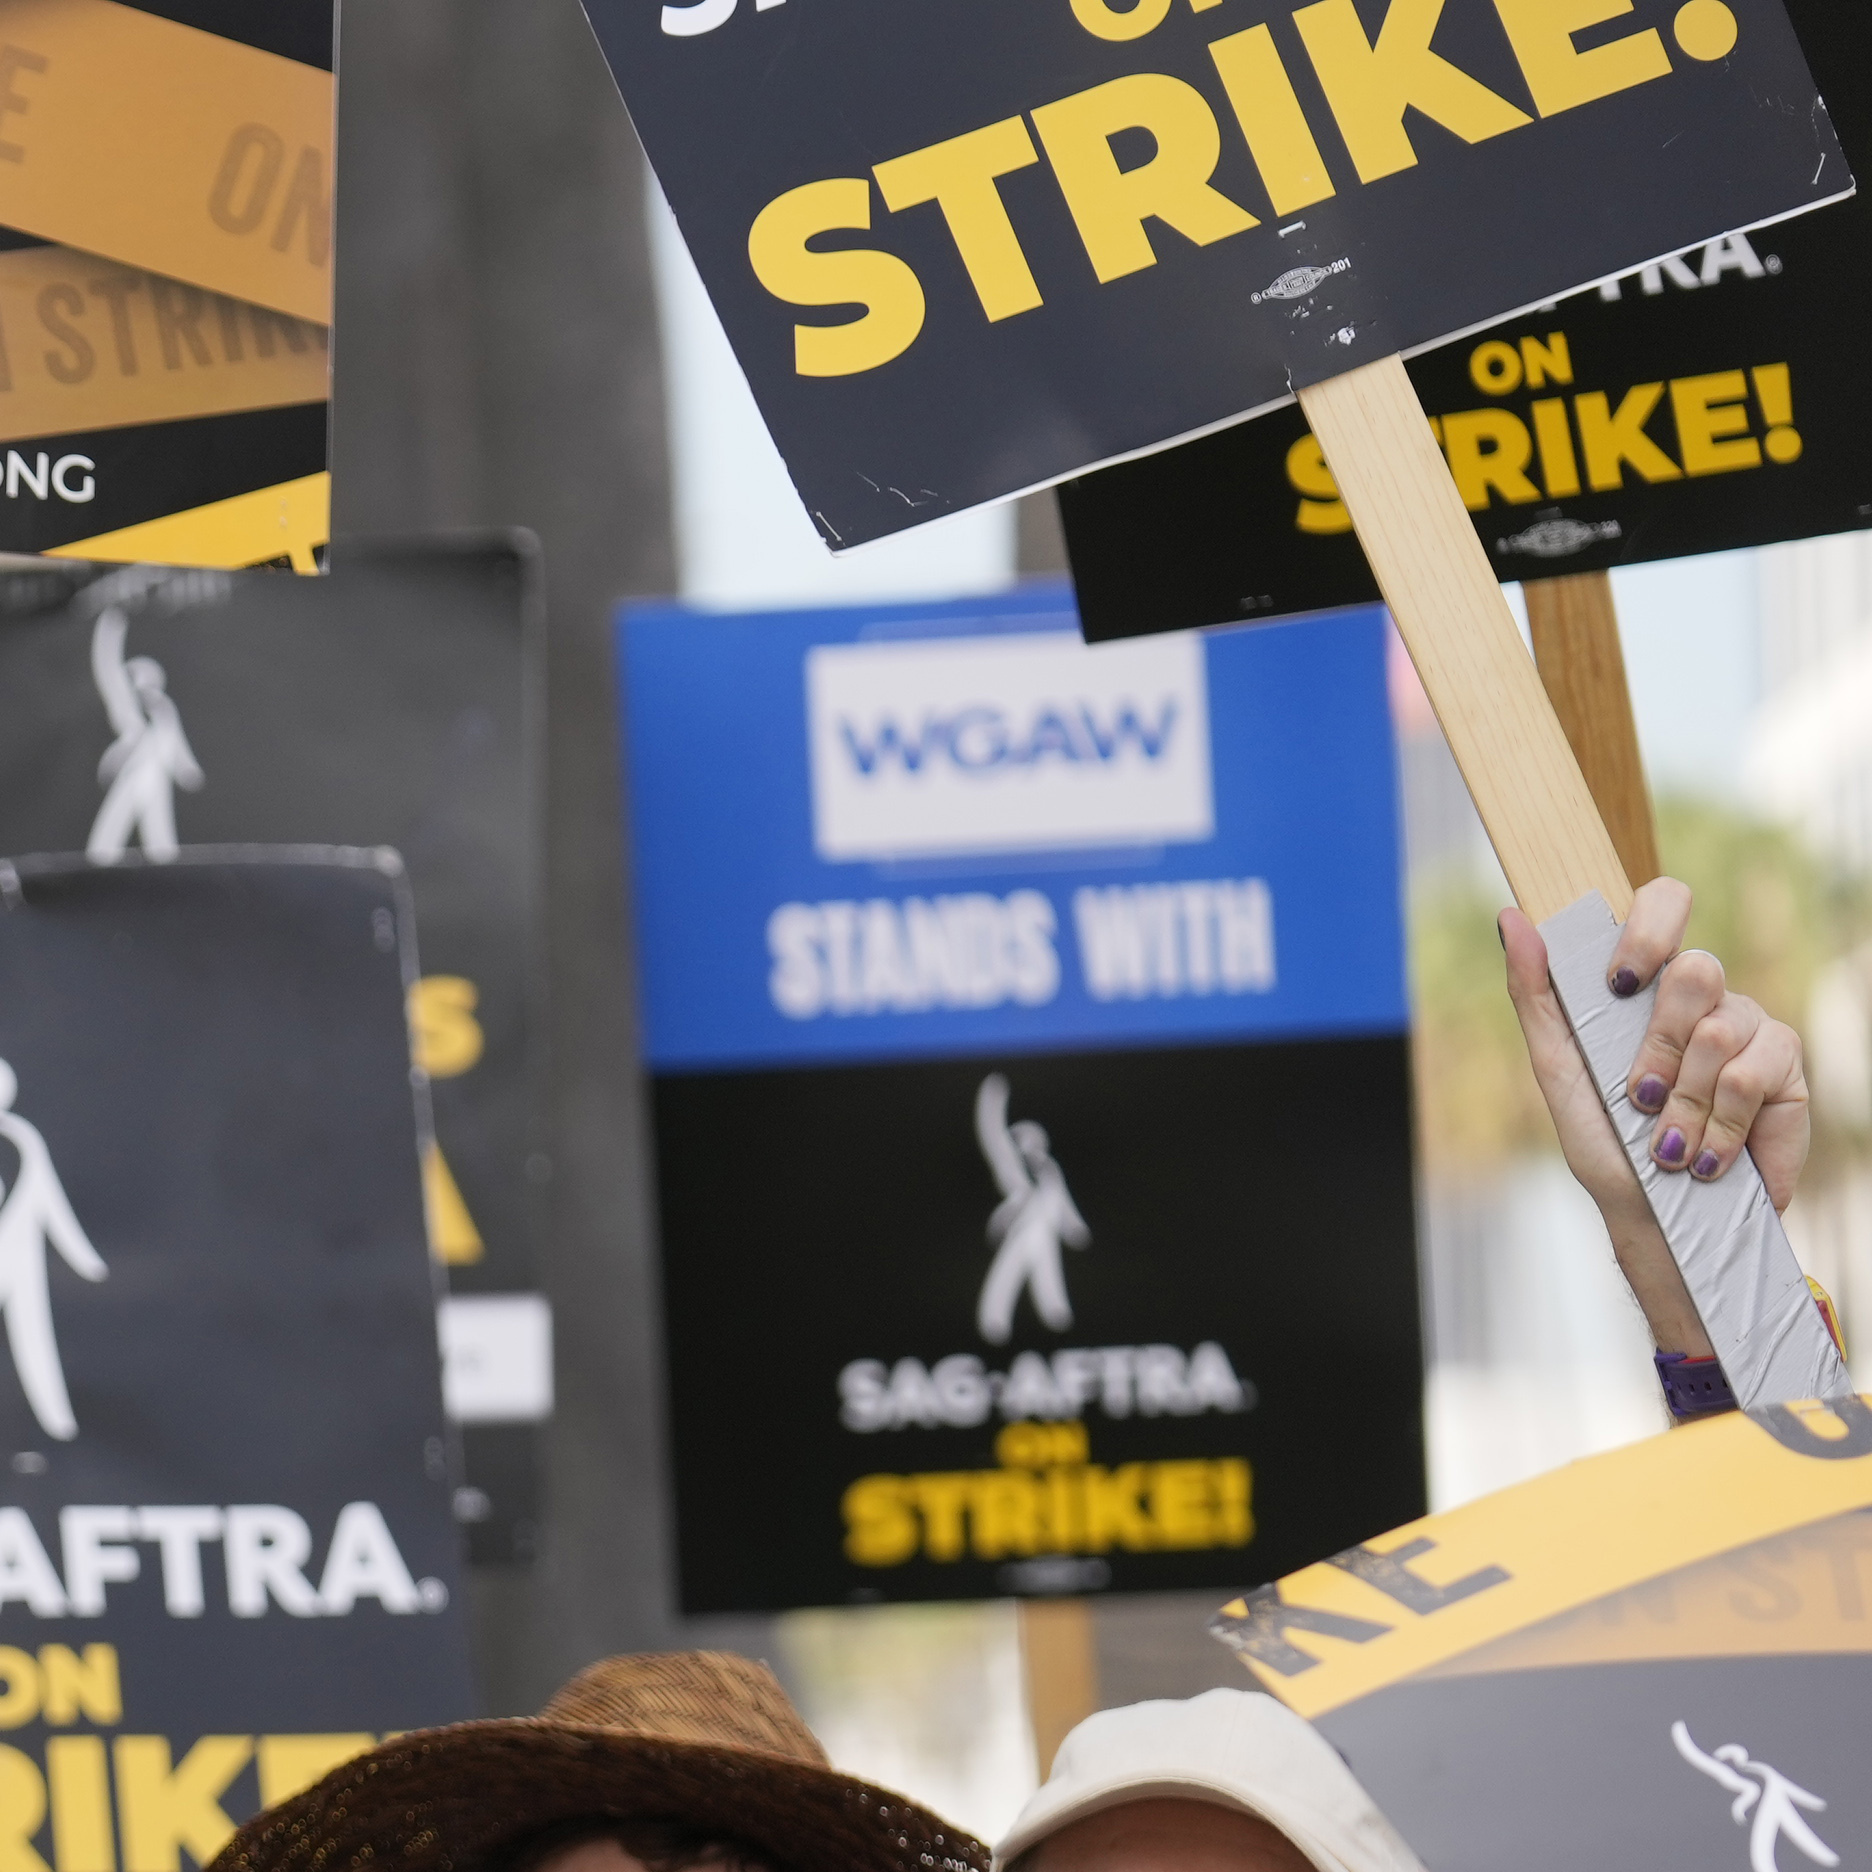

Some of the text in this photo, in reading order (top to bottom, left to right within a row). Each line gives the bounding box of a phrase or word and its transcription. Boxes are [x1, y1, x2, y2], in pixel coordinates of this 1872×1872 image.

[1469, 330, 1574, 396] ON
[839, 694, 1182, 778] WGAW
[767, 877, 1277, 1020] STANDS WITH
[996, 1420, 1090, 1475] ON
[842, 1456, 1255, 1568] STRIKE!
